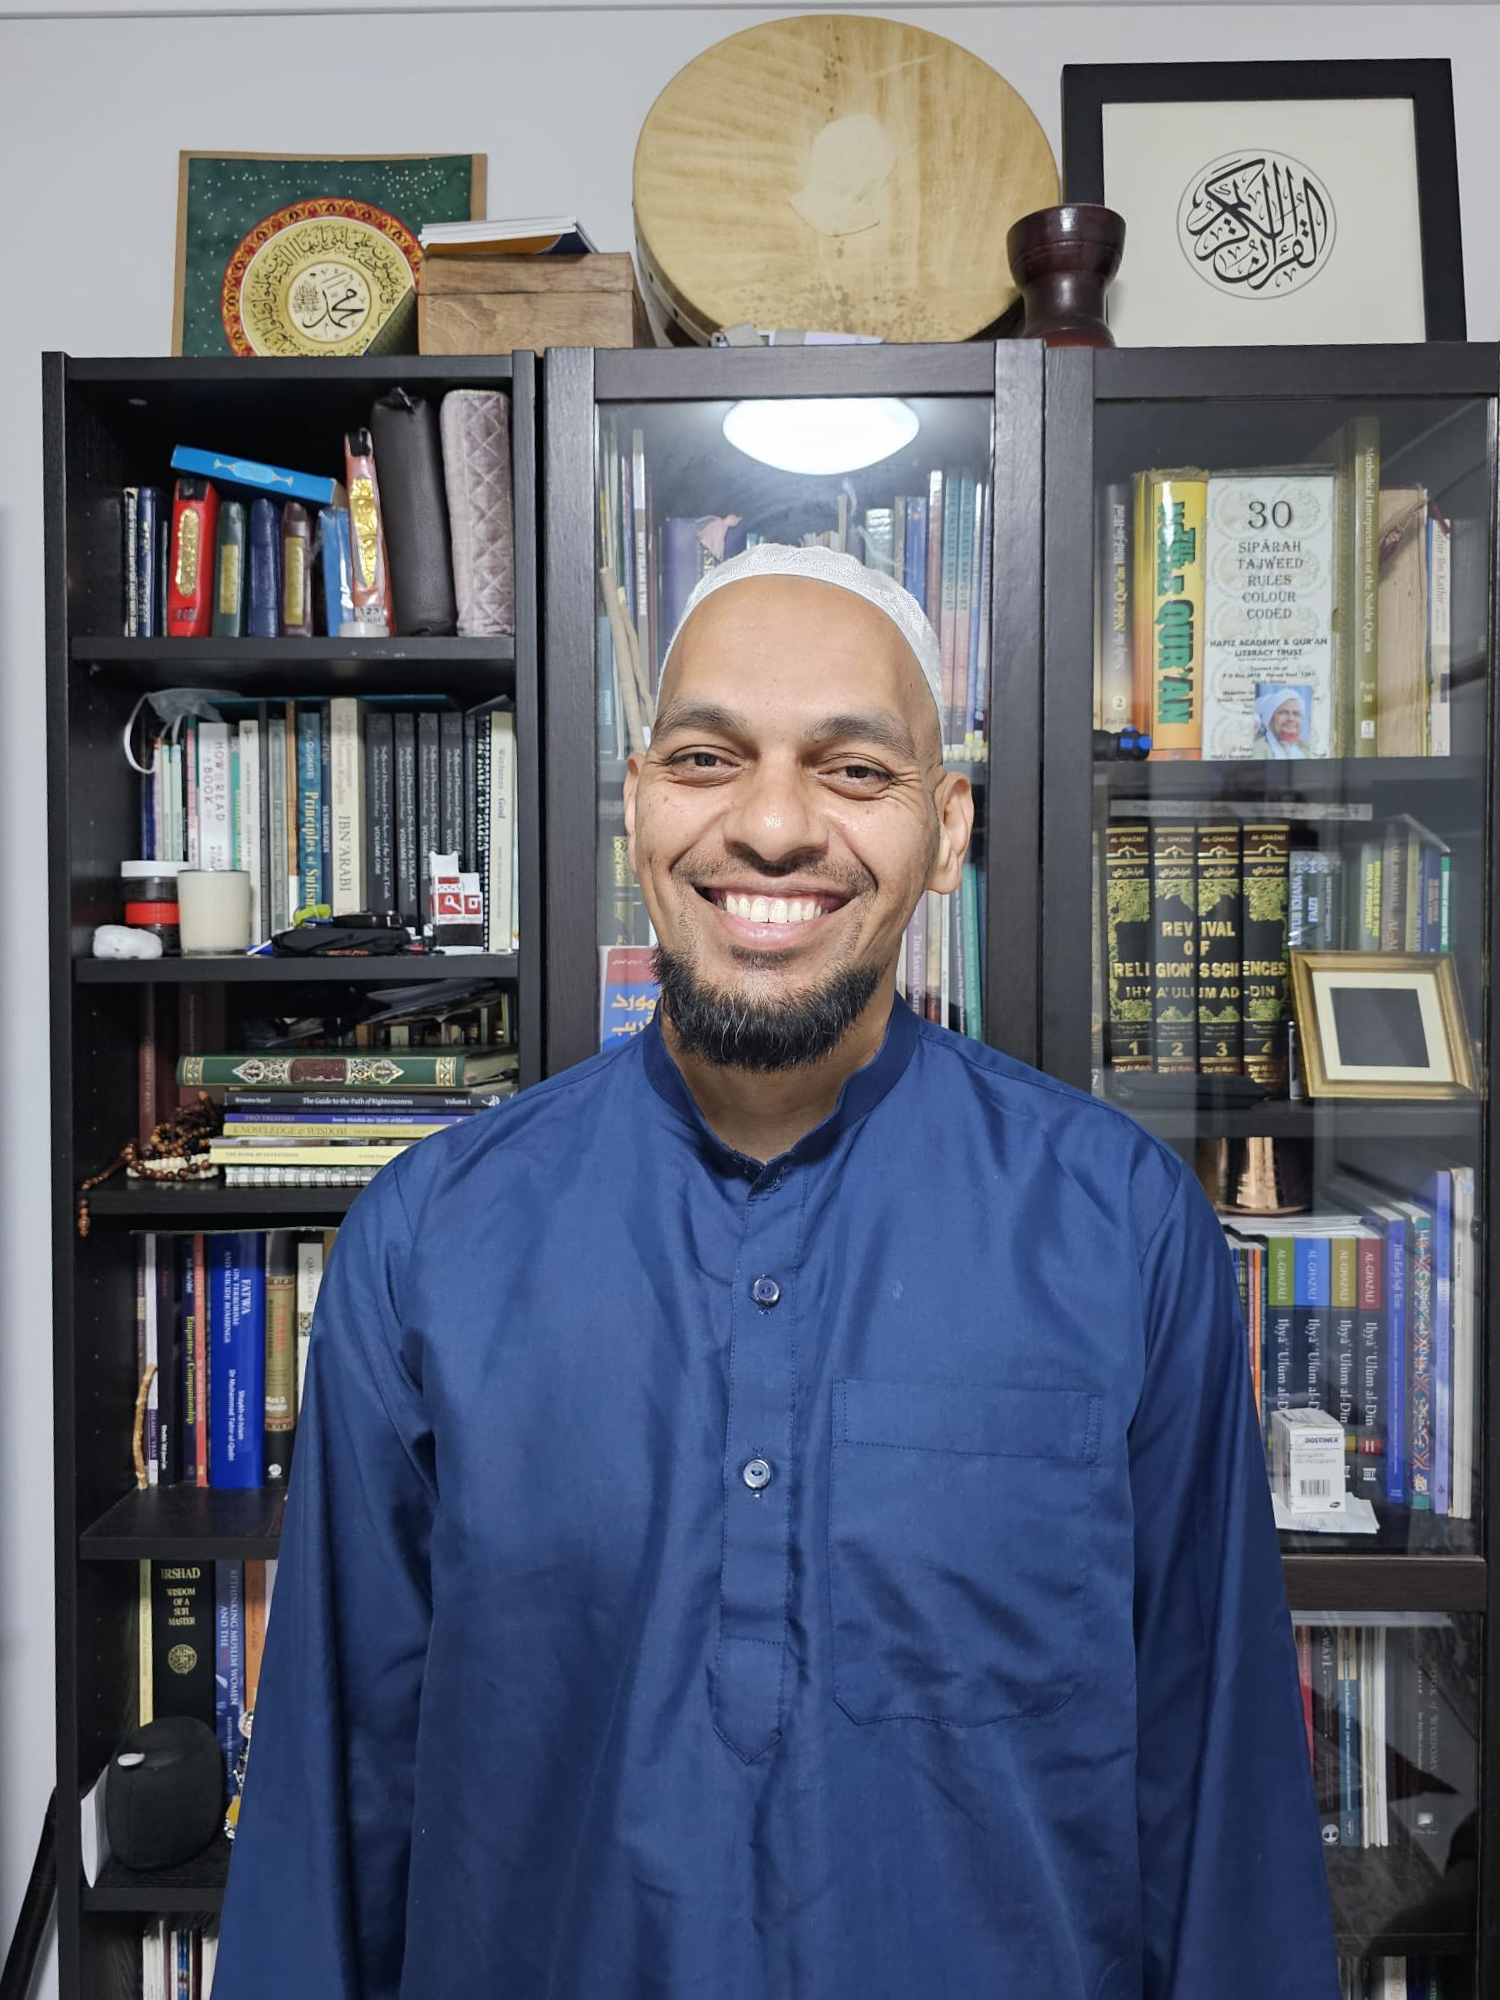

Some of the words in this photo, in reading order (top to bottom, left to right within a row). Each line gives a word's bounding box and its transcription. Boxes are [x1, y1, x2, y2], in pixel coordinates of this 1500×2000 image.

[302, 288, 365, 329] محمد
[1365, 446, 1375, 497] Methodical
[1247, 500, 1293, 530] 30
[949, 510, 957, 558] ENDLESS
[962, 510, 970, 558] ENDLESS
[1362, 500, 1375, 562] Interpretation
[1238, 539, 1301, 553] SIPĀRAH
[639, 555, 647, 583] ISLAM
[1237, 557, 1304, 570] TAJWEED
[1364, 564, 1374, 575] of
[639, 584, 647, 592] IS
[946, 561, 955, 612] BANQUET
[960, 561, 968, 611] BANQUET
[1248, 574, 1292, 587] RULES
[1364, 576, 1374, 591] the
[640, 594, 648, 616] TRUE
[1242, 590, 1297, 603] COLOUR
[1364, 592, 1374, 619] Noble
[1114, 603, 1126, 632] Noble
[1246, 608, 1292, 620] CODED
[1209, 639, 1237, 648] HAFIZ
[1239, 638, 1279, 647] ACADEMY
[1282, 638, 1290, 646] &
[1292, 637, 1328, 646] QUR'AN
[1362, 620, 1374, 653] Qur'an
[1157, 600, 1194, 725] QUR'AN
[1234, 649, 1274, 658] LITERACY
[1277, 648, 1303, 656] TRUST
[214, 741, 226, 770] HOW
[204, 766, 213, 804] BOOK
[214, 784, 226, 822] READ
[498, 798, 507, 819] God
[301, 791, 319, 853] Principles
[339, 816, 352, 841] IBN
[1364, 863, 1373, 887] HOLY
[1372, 860, 1381, 905] MIRACLES
[1308, 897, 1319, 923] FAIZI
[1364, 888, 1373, 930] PROPHET
[1372, 906, 1381, 918] OF
[1372, 920, 1381, 938] THE
[912, 934, 923, 953] THE
[1128, 1041, 1138, 1055] 1
[1171, 1042, 1184, 1057] 2
[1215, 1042, 1229, 1057] 3
[1261, 1041, 1272, 1054] 4
[303, 1096, 314, 1105] The
[315, 1096, 332, 1105] Guide
[340, 1096, 350, 1105] the
[351, 1096, 364, 1105] Path
[365, 1096, 372, 1105] of
[372, 1097, 413, 1107] Righteousness
[445, 1096, 465, 1105] Volume
[233, 1125, 295, 1136] KNOWLEDGE
[307, 1125, 348, 1136] WISDOM
[224, 1251, 232, 1268] AND
[1391, 1262, 1404, 1278] Early
[224, 1270, 232, 1300] SUICIDE
[232, 1268, 240, 1281] ON
[1390, 1279, 1403, 1291] Sufi
[232, 1283, 240, 1326] TERRORISM
[241, 1279, 251, 1316] FATWA
[224, 1302, 232, 1344] BOMBINGS
[184, 1316, 195, 1355] Etiquettes
[228, 1369, 236, 1378] Dr
[186, 1363, 197, 1426] Companionship
[228, 1379, 236, 1416] Muhammad
[1339, 1387, 1351, 1423] al-Dīn
[1365, 1389, 1378, 1426] al-Dīn
[1305, 1436, 1339, 1445] DOSTINEX
[161, 1567, 201, 1580] IRSHAD
[166, 1587, 196, 1597] WISDOM
[173, 1598, 184, 1606] OF
[229, 1569, 238, 1621] RETHINKING
[168, 1616, 196, 1626] MASTER
[173, 1607, 189, 1616] SUFI
[220, 1605, 229, 1628] AND
[220, 1630, 229, 1648] THE
[229, 1623, 239, 1667] MUSLIM
[229, 1669, 239, 1706] WOMEN
[1429, 1713, 1439, 1772] WISDOMS
